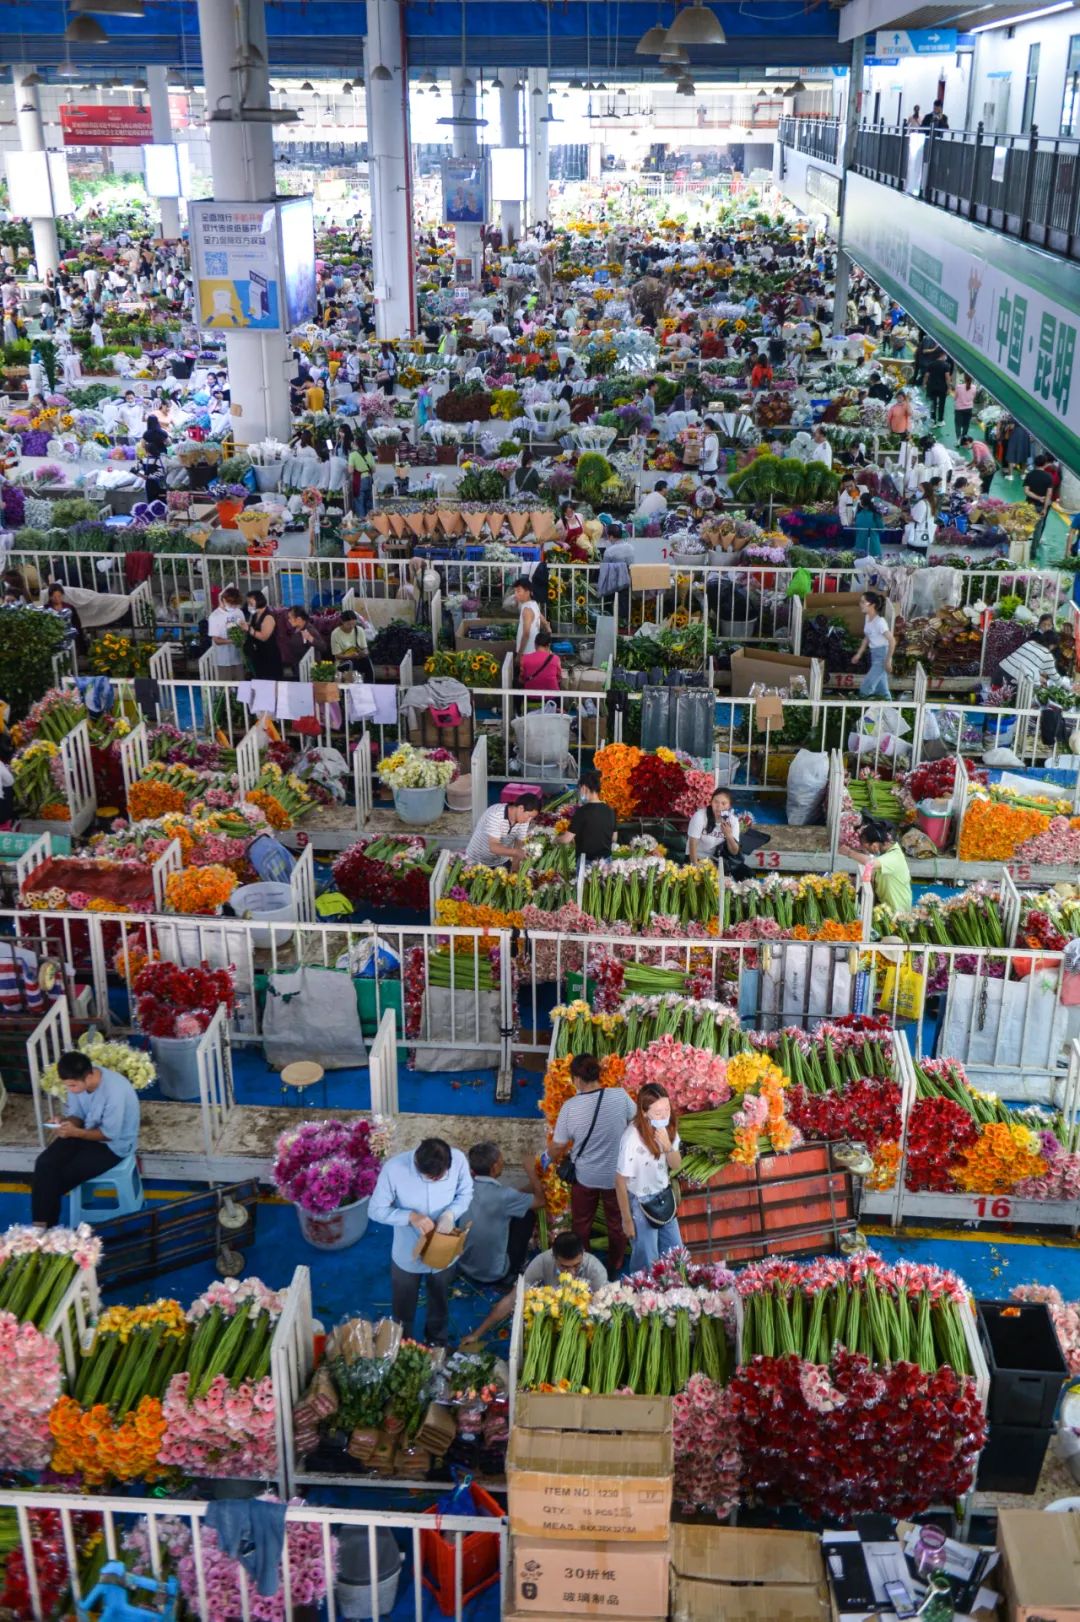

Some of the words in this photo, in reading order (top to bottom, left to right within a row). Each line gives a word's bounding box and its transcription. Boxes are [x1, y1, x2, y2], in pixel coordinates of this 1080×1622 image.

[755, 851, 781, 868] 13
[973, 1197, 1010, 1218] 16
[544, 1487, 571, 1496] ITEM
[563, 1592, 619, 1606] 玻璃制品
